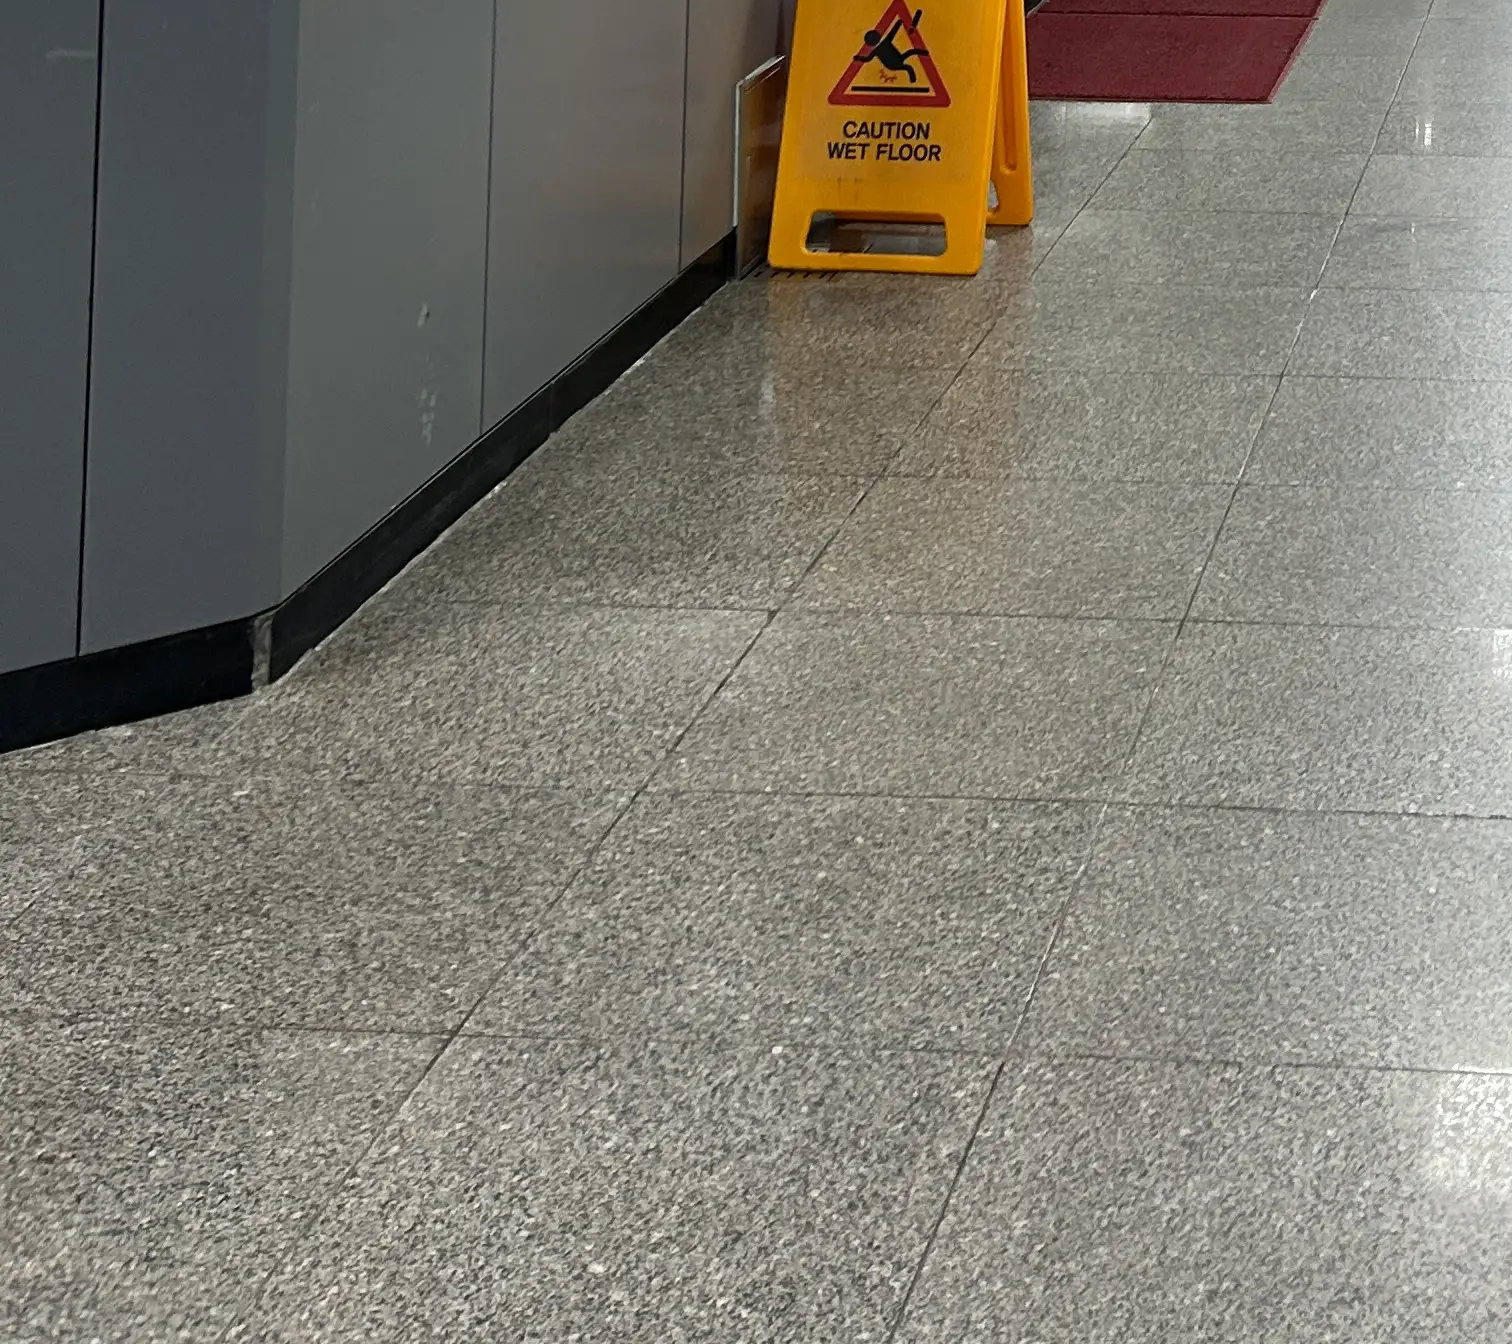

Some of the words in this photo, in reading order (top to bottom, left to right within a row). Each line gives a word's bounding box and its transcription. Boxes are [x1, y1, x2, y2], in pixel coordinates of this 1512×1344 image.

[842, 120, 930, 141] CAUTION
[828, 141, 871, 161] WET
[875, 142, 942, 162] FLOOR
